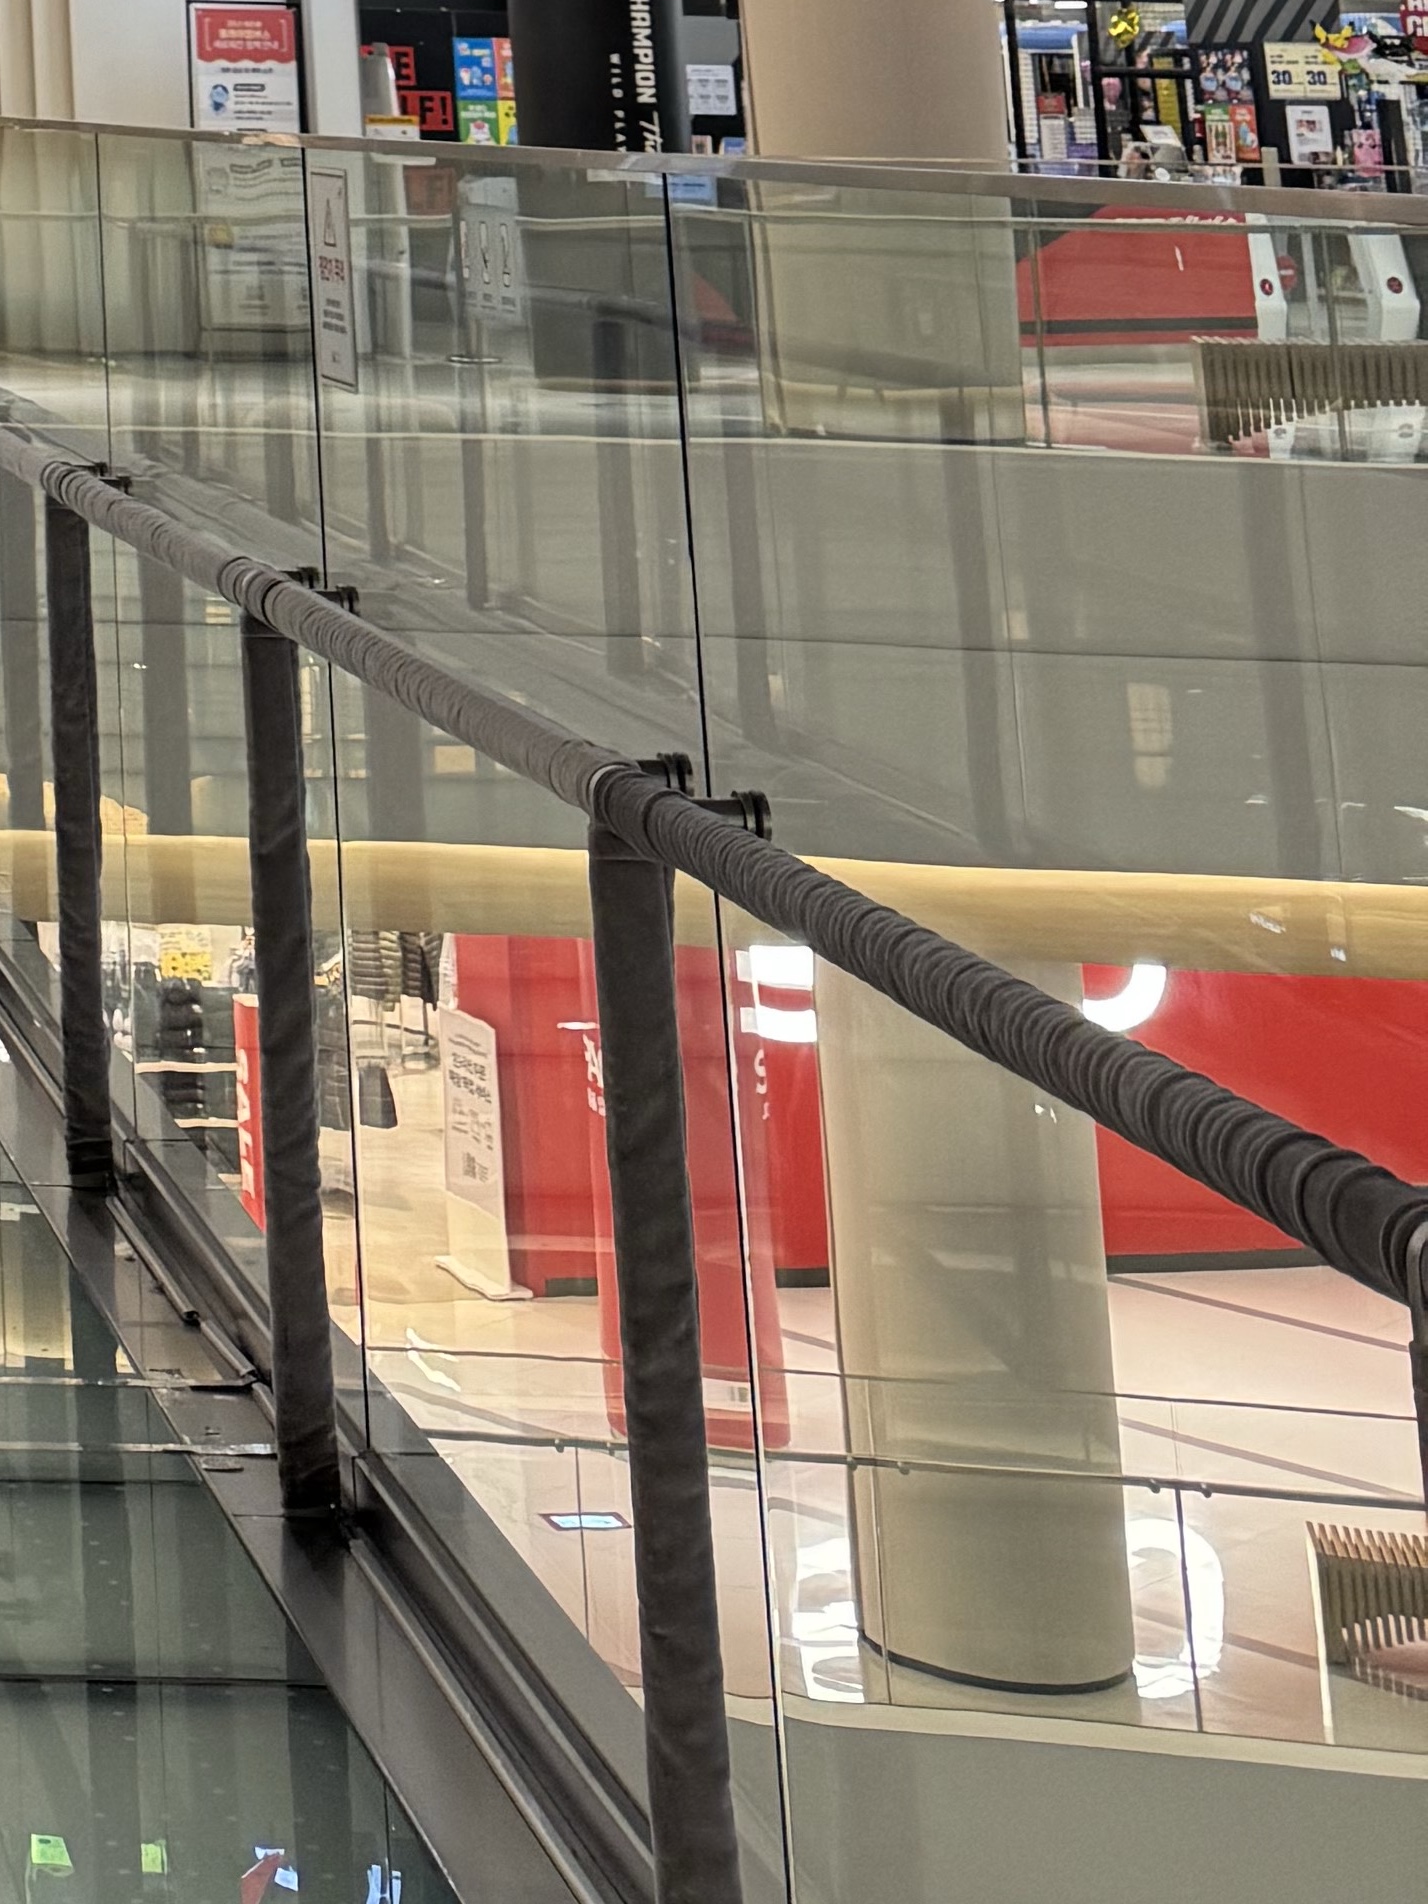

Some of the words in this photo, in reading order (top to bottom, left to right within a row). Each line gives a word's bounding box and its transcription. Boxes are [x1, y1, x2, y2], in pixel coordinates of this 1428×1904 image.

[609, 53, 624, 98] WILD
[1271, 69, 1293, 86] 30
[1306, 70, 1327, 86] 30
